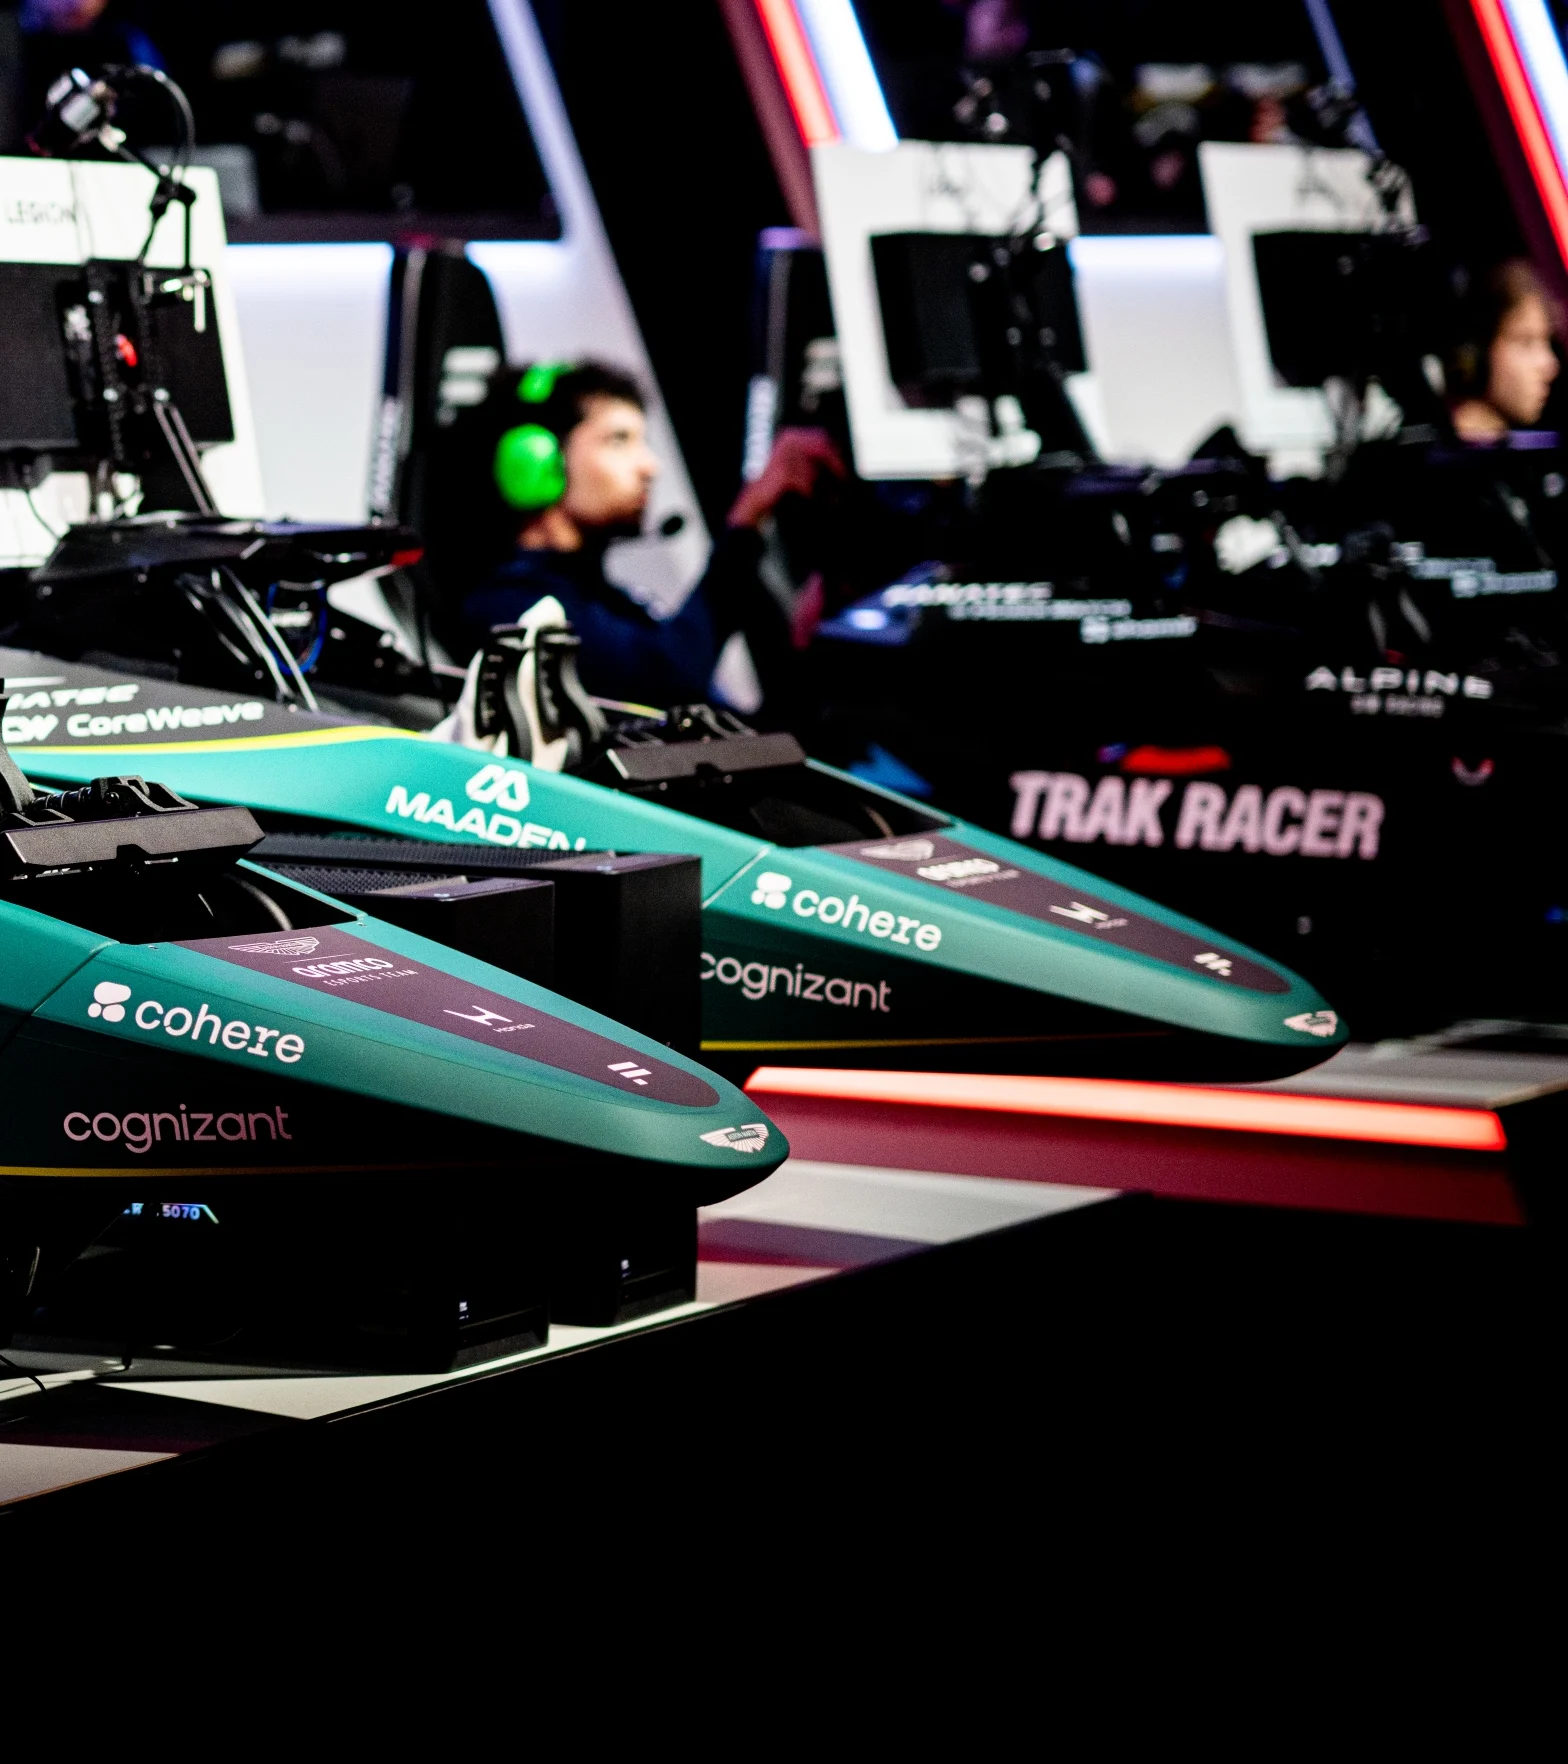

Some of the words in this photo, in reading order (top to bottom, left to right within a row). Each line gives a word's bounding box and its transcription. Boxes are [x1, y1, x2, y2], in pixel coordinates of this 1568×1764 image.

[1305, 665, 1493, 699] ALPINE
[66, 701, 265, 738] CoreWeave
[1010, 769, 1174, 848] TRAK
[1175, 780, 1386, 861] RACER
[792, 889, 942, 951] cohere
[292, 957, 394, 978] aramco
[135, 1000, 305, 1063] cohere
[63, 1103, 293, 1154] cognizant
[162, 1204, 201, 1220] 5070
